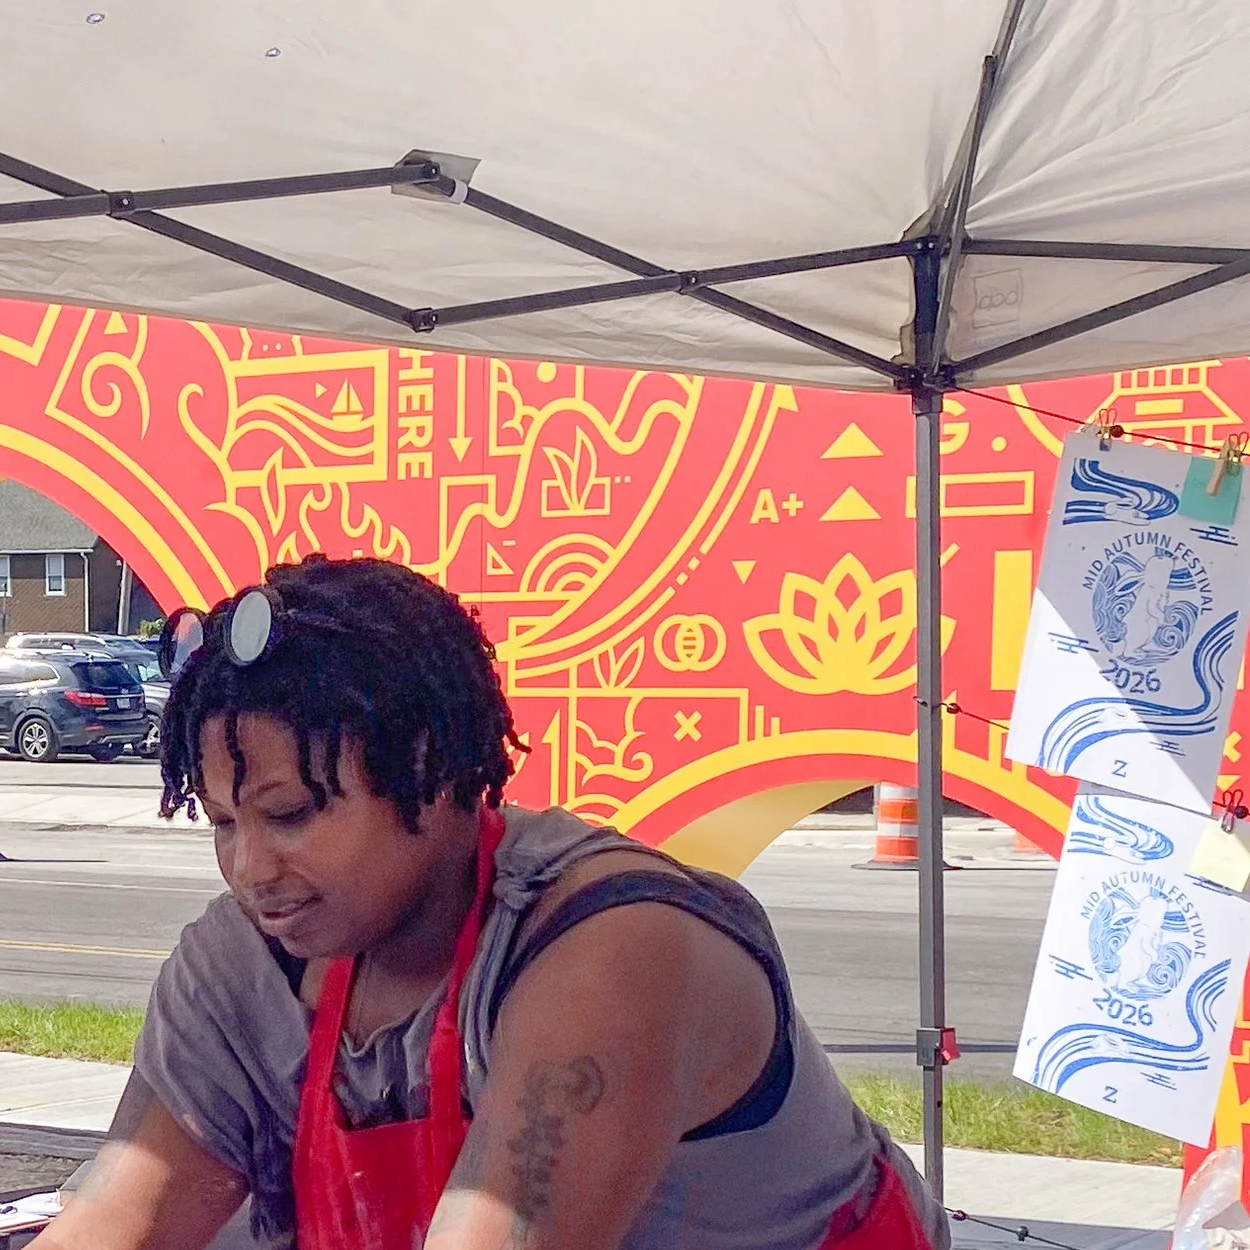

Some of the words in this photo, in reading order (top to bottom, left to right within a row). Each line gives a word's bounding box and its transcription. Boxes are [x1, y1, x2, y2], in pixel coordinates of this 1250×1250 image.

[750, 488, 804, 525] A+
[1082, 560, 1103, 590] MID
[1104, 531, 1172, 560] AUTUMN
[1174, 542, 1213, 615] FESTIVAL
[1098, 659, 1161, 693] 2026
[1111, 760, 1127, 778] Z
[1080, 891, 1100, 919] MID
[1101, 871, 1166, 895] AUTUMN
[1168, 885, 1207, 959] FESTIVAL
[1092, 988, 1153, 1026] 2026
[1103, 1086, 1119, 1104] Z
